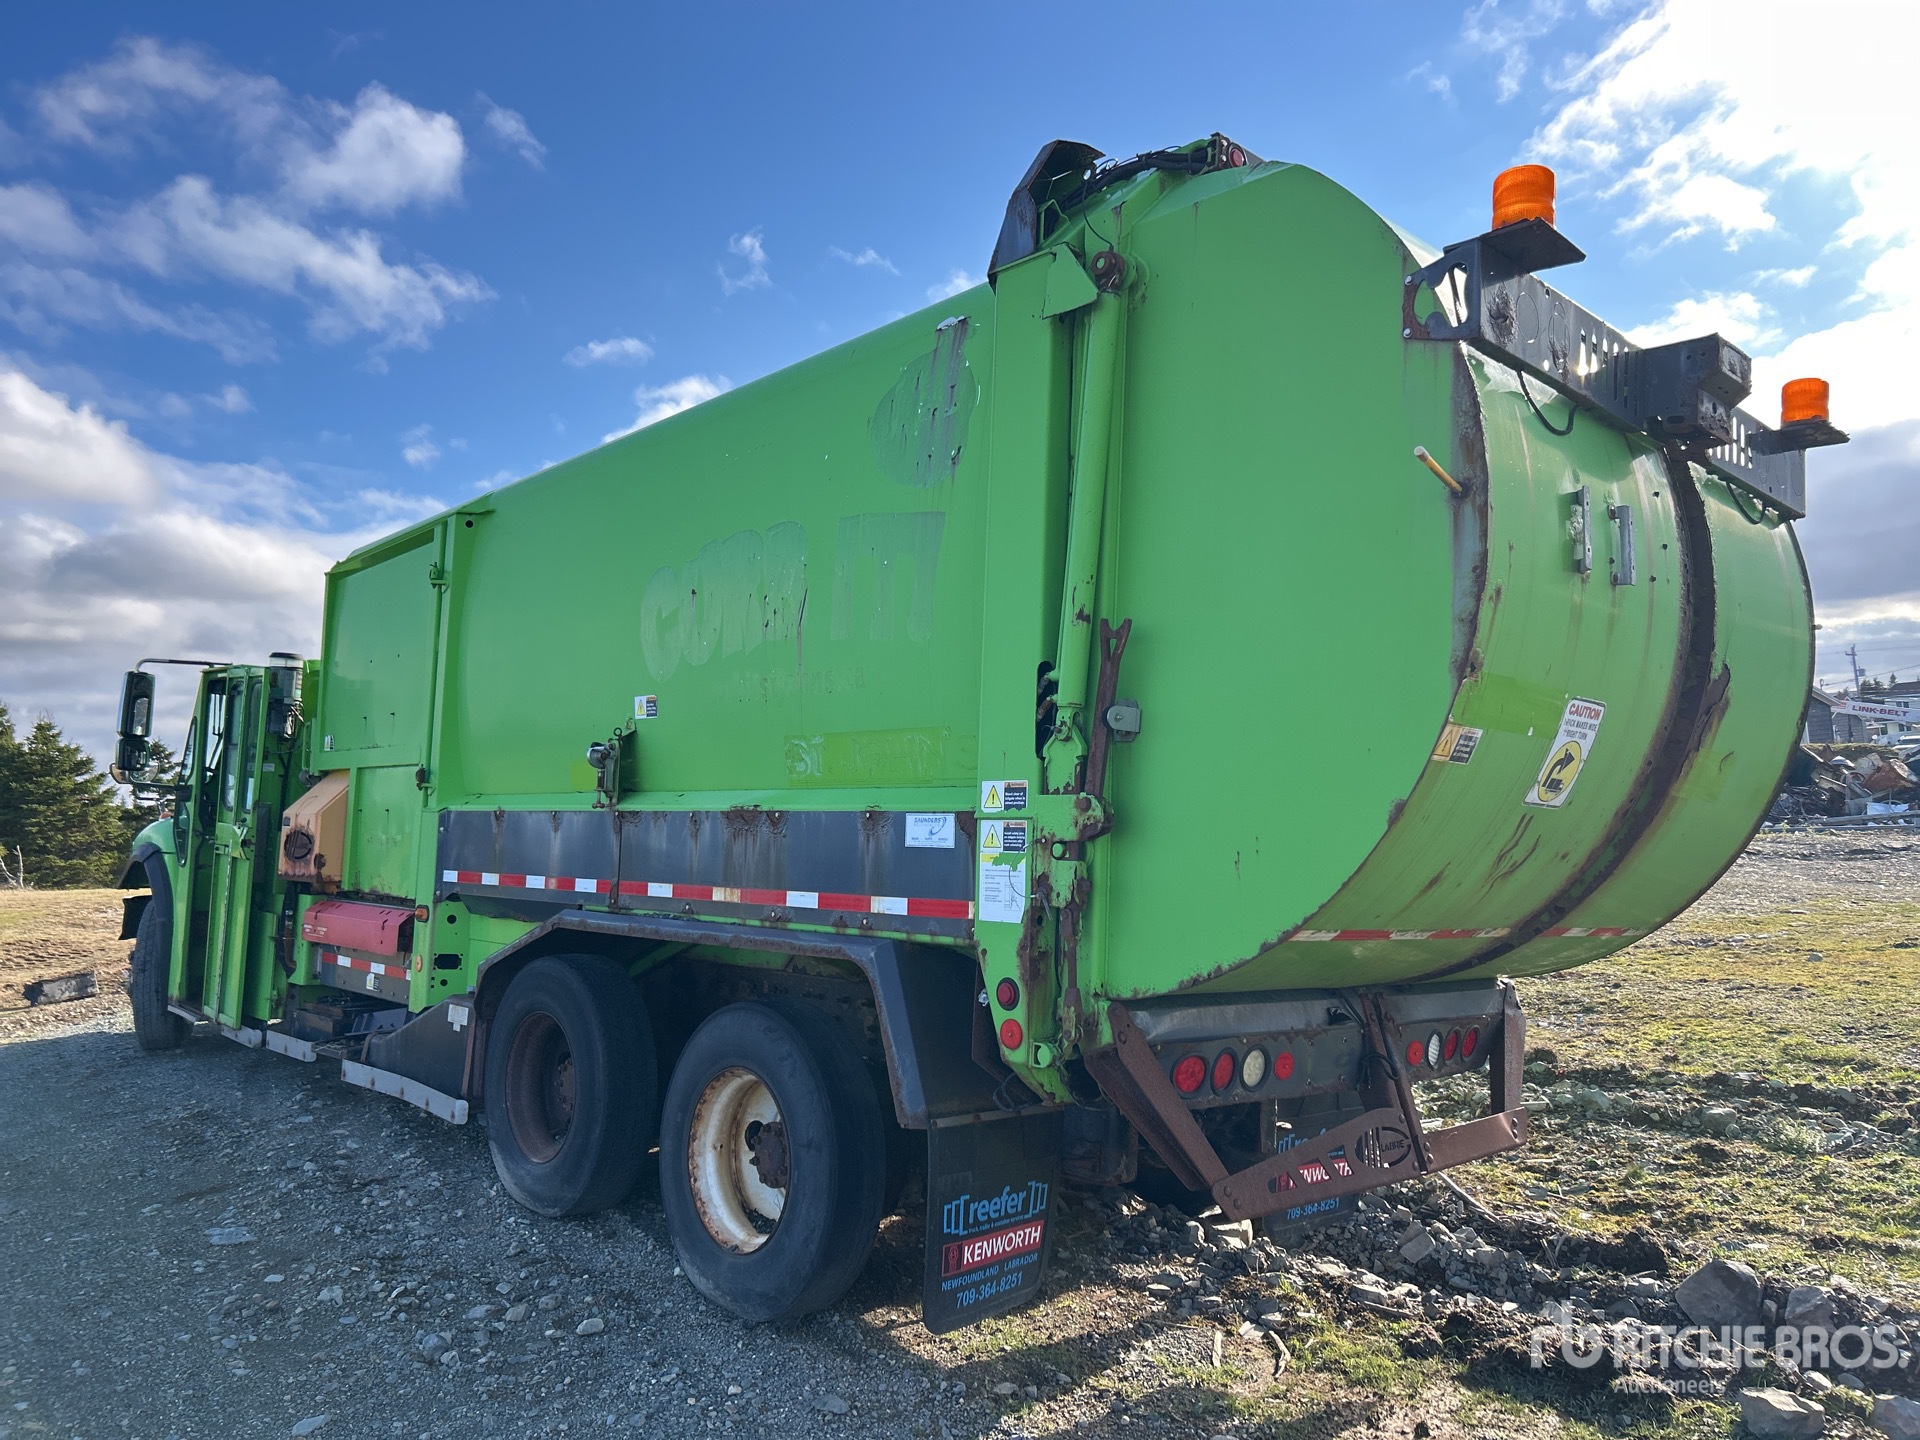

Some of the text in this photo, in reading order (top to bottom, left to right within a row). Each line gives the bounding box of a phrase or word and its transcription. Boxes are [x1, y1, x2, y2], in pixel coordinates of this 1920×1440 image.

[1568, 703, 1602, 720] CAUTION
[1852, 704, 1909, 717] LINK-BELT
[969, 1185, 1026, 1224] reefer
[1287, 1197, 1340, 1220] 709-364-8251
[963, 1225, 1041, 1265] KENWORTH
[941, 1252, 1038, 1292] NEWFOUNDLAND LABRADOR
